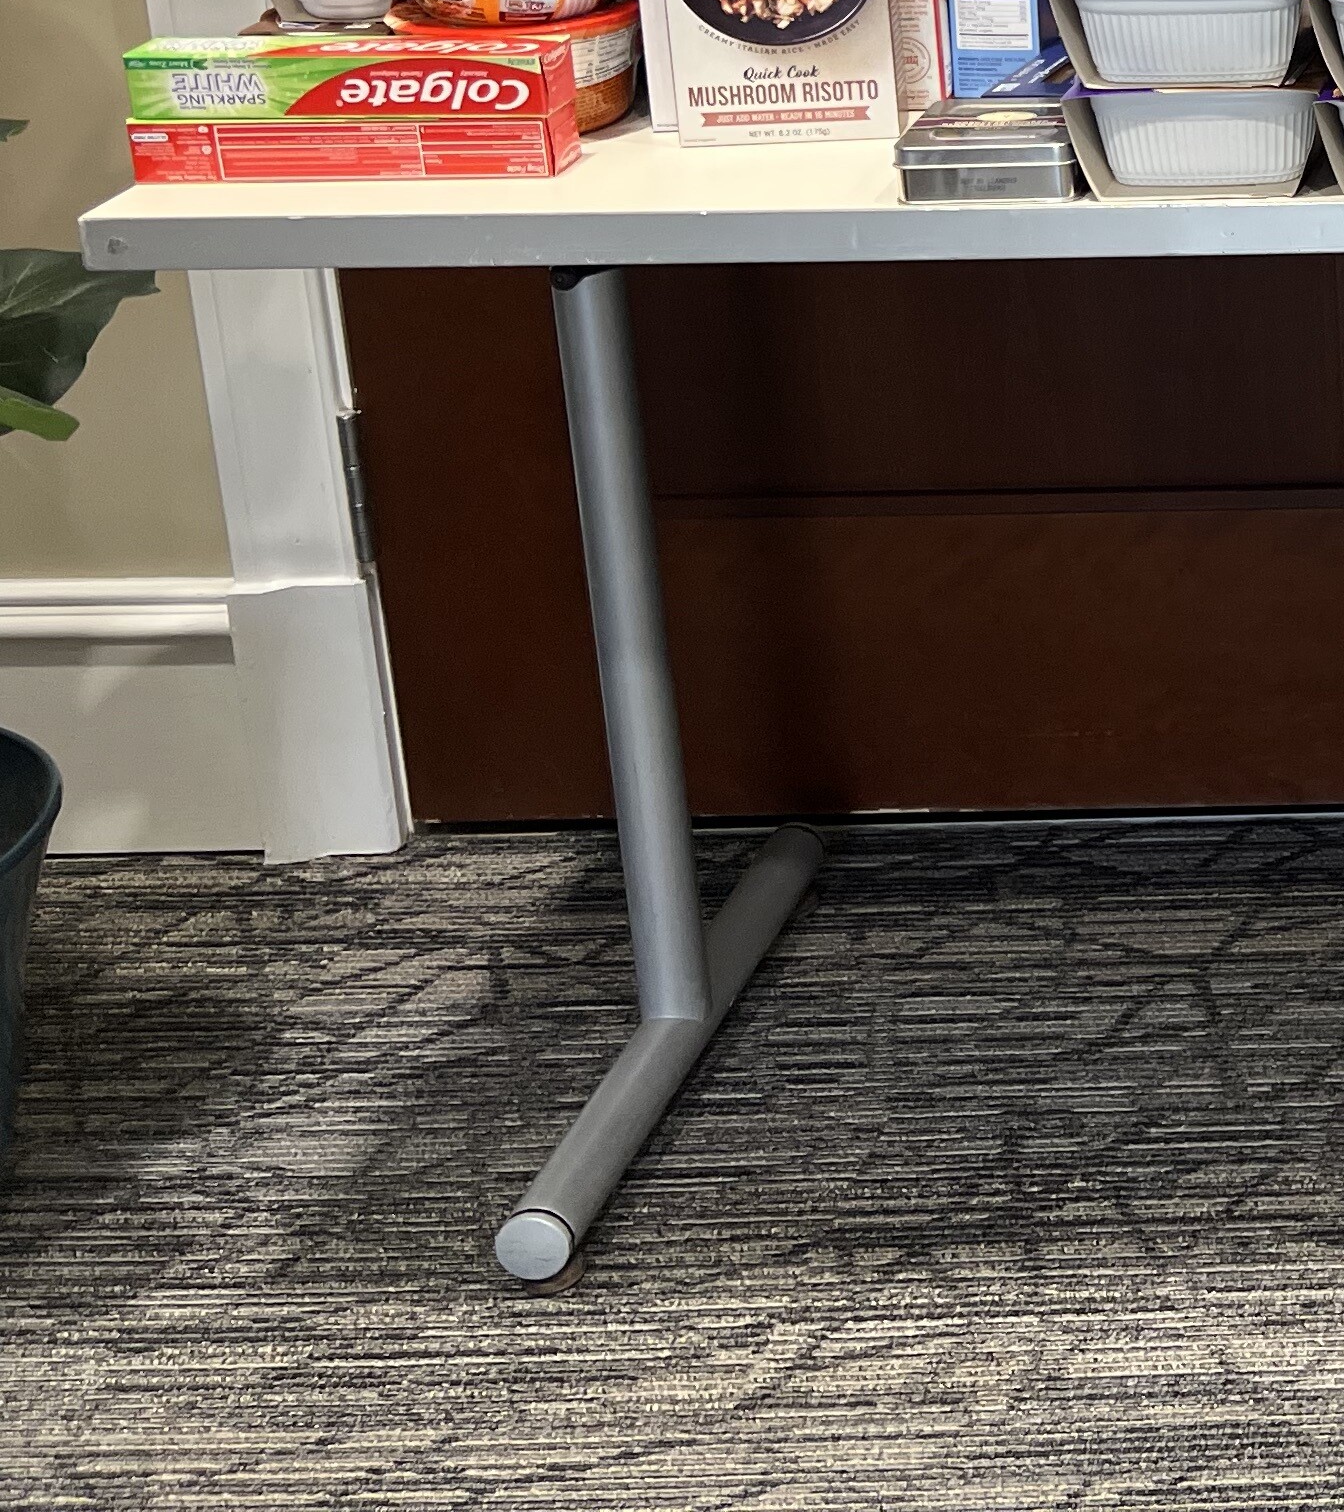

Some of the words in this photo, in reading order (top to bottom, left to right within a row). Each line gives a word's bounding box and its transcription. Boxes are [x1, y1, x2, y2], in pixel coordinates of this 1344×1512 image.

[698, 24, 735, 48] CREAMY
[737, 43, 778, 55] ITALIAN
[171, 73, 265, 93] WHITE
[743, 67, 782, 81] Quick
[787, 64, 821, 79] Cook
[178, 92, 266, 106] SPARKLING
[335, 71, 531, 111] Colgate
[688, 85, 796, 107] MUSHROOM
[803, 79, 879, 102] RISOTTO
